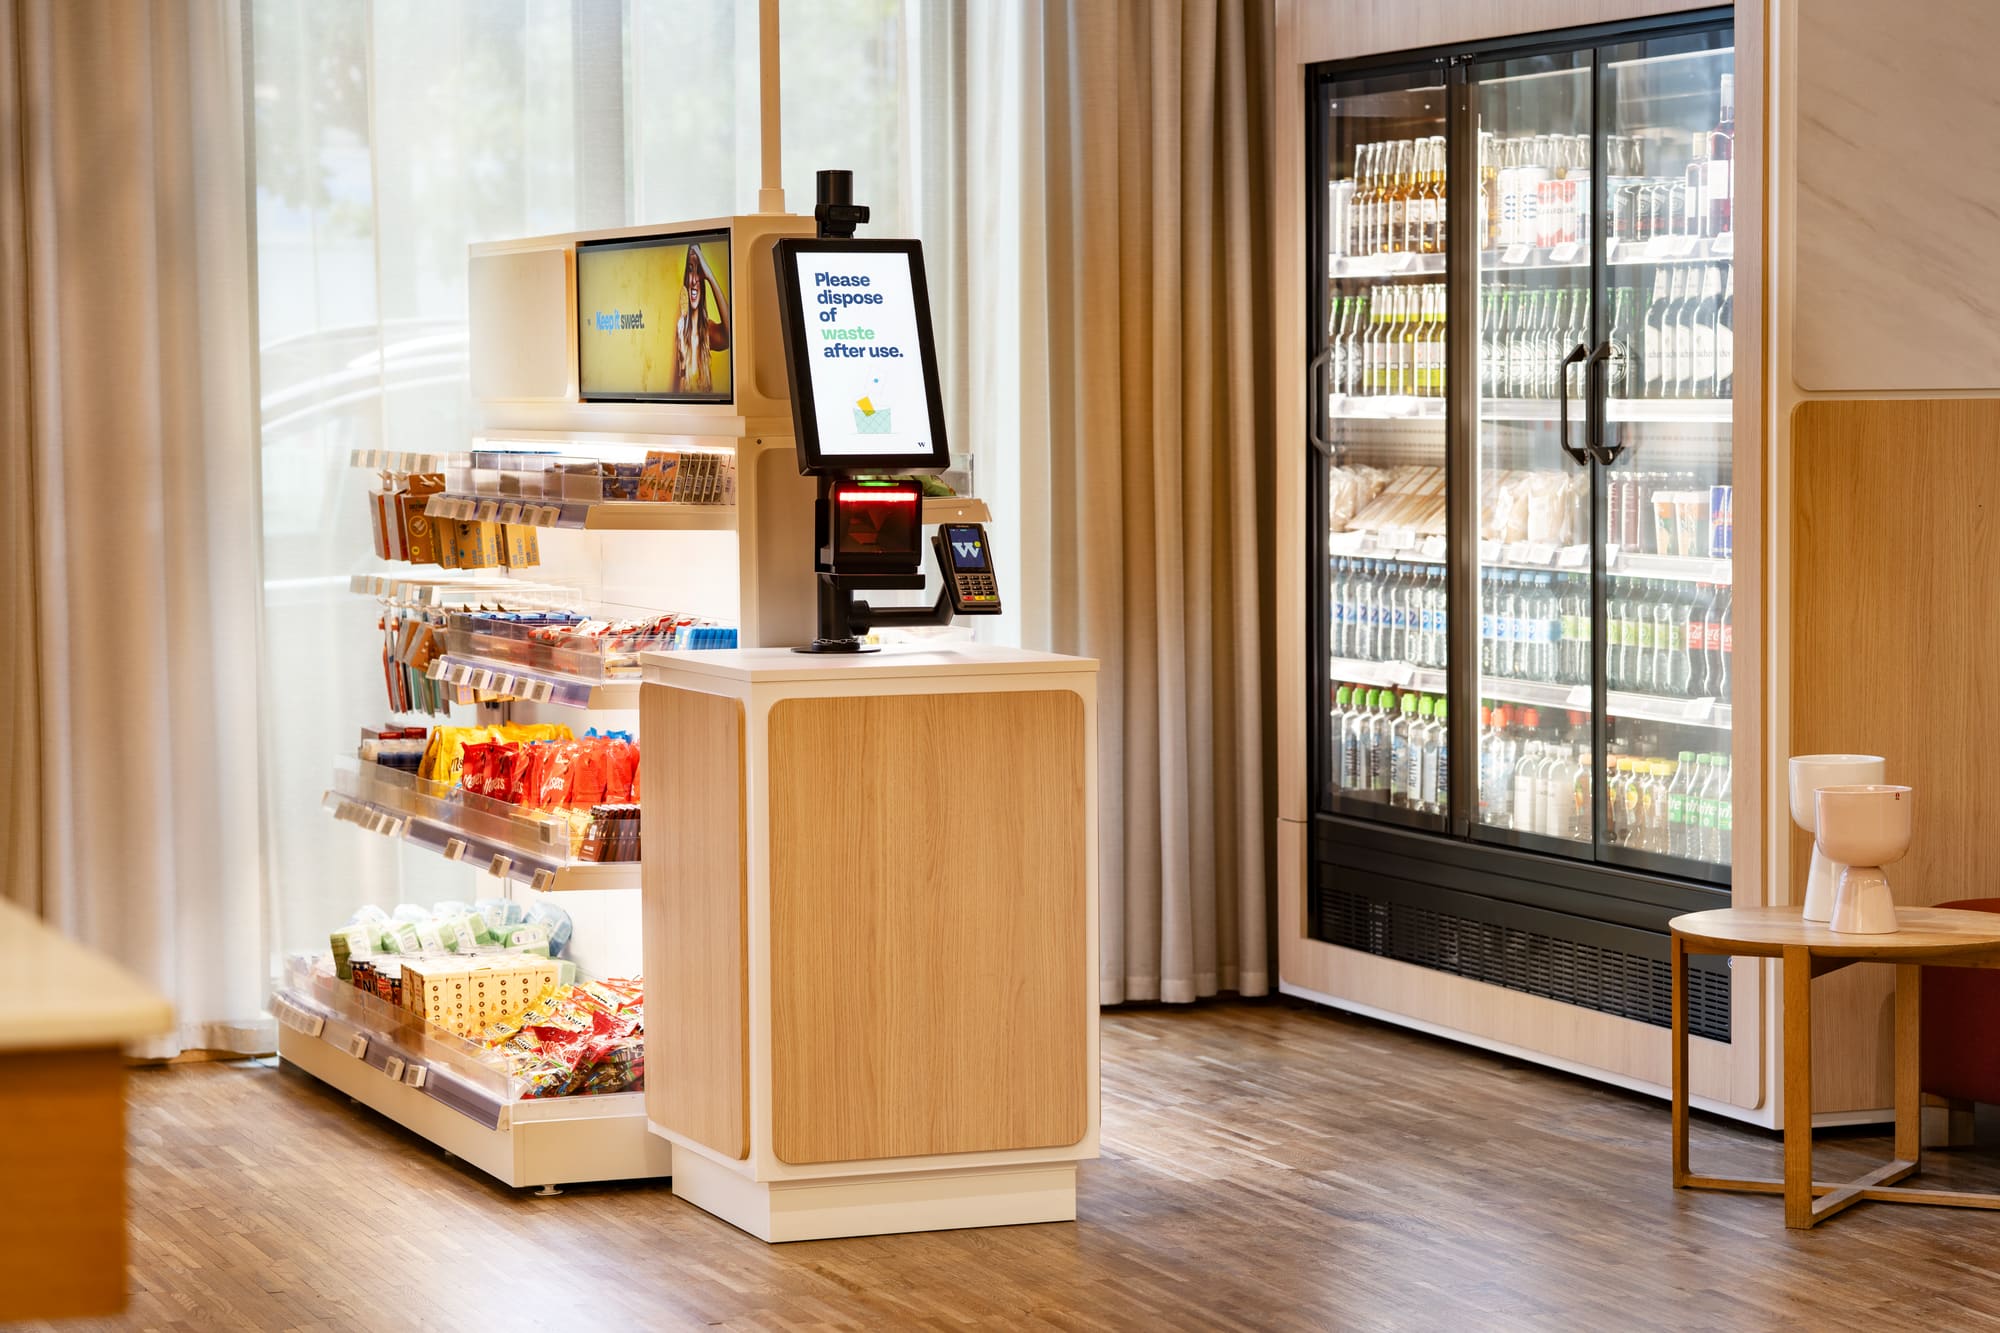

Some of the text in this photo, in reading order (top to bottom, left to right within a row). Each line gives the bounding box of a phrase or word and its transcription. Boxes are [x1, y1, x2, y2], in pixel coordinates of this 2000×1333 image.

[815, 272, 871, 287] Please
[817, 290, 884, 308] dispose
[596, 309, 645, 335] Keep it sweet.
[819, 307, 838, 322] of
[821, 326, 875, 340] waste
[824, 343, 904, 358] after use.
[952, 542, 981, 558] W
